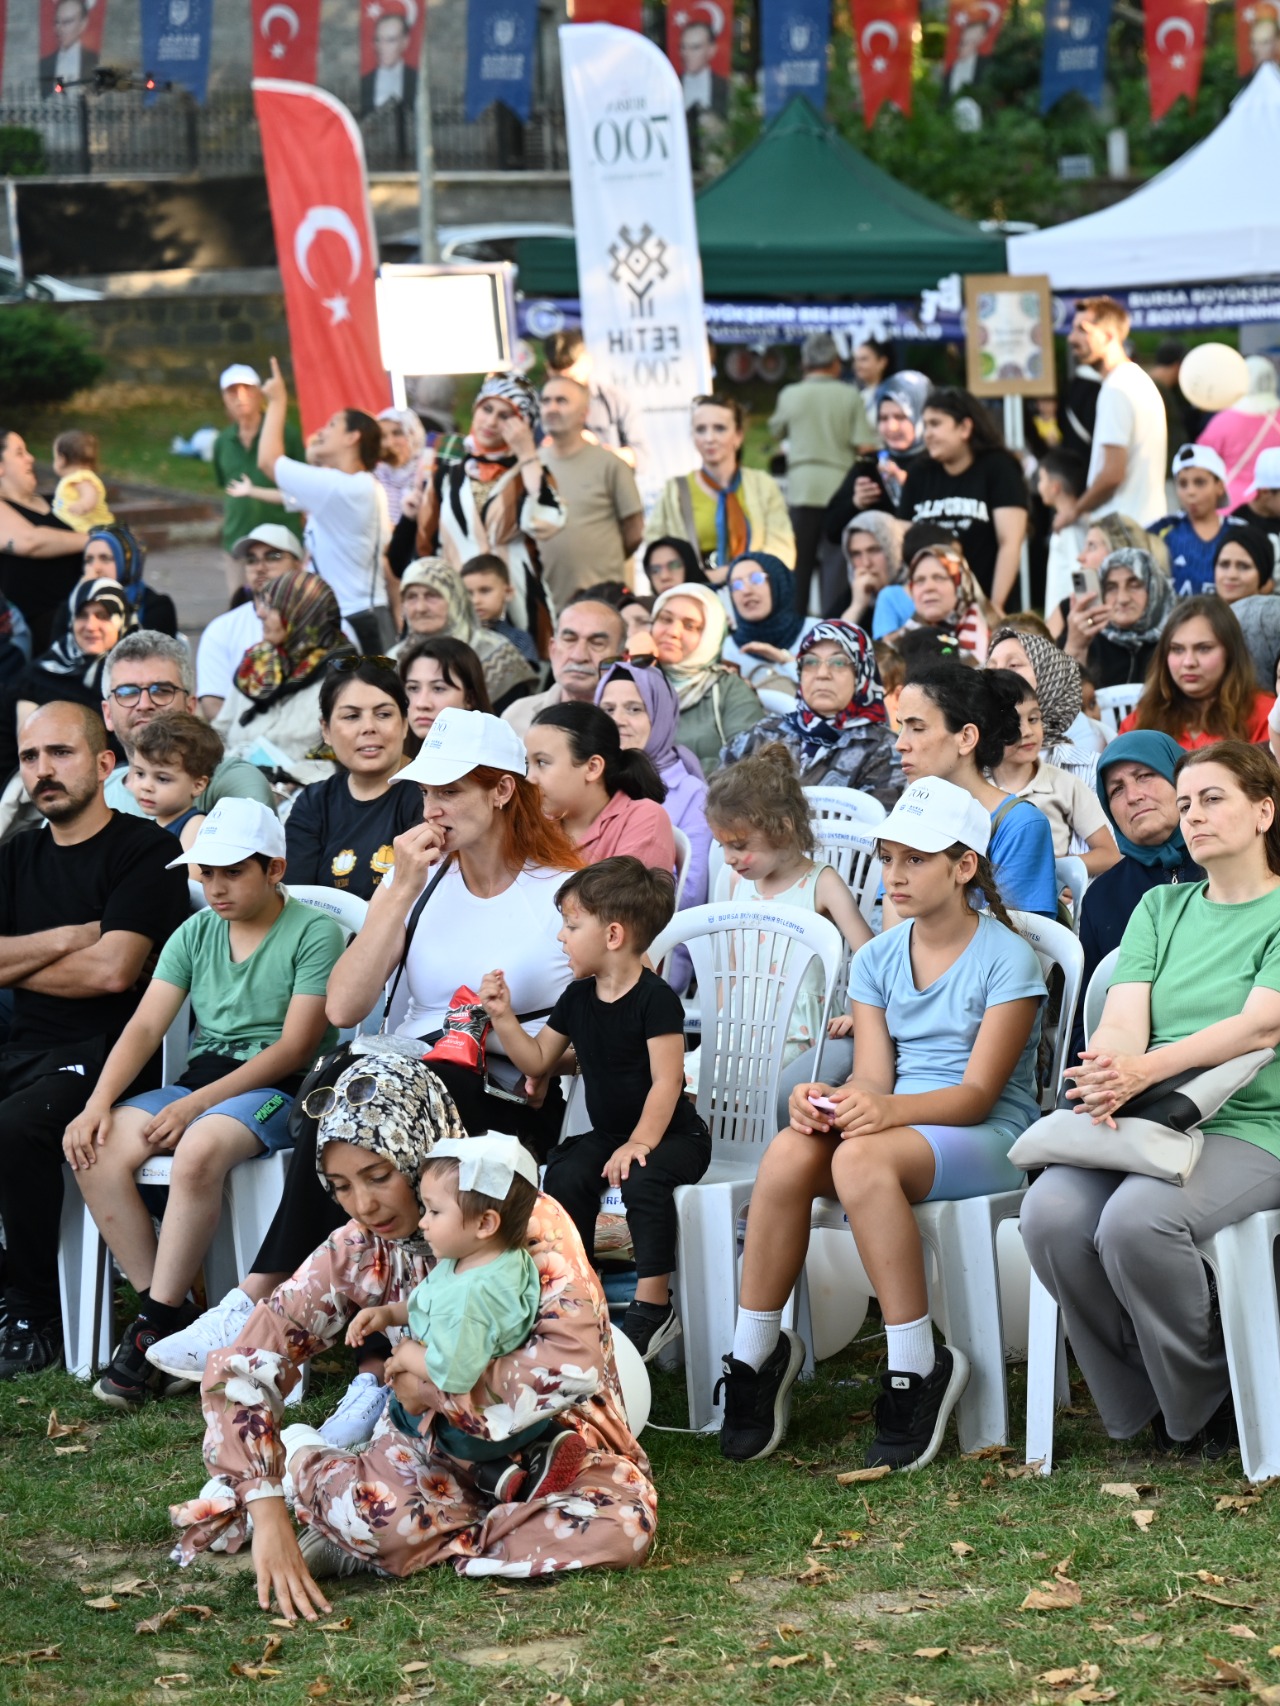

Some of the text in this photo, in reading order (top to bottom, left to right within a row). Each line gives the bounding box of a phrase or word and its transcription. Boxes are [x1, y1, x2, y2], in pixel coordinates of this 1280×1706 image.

[1127, 289, 1190, 309] BURSA
[909, 788, 930, 800] 700
[314, 899, 343, 915] BELEDİYESİ
[718, 913, 739, 922] BURSA
[776, 917, 806, 935] BELEDİYESİ
